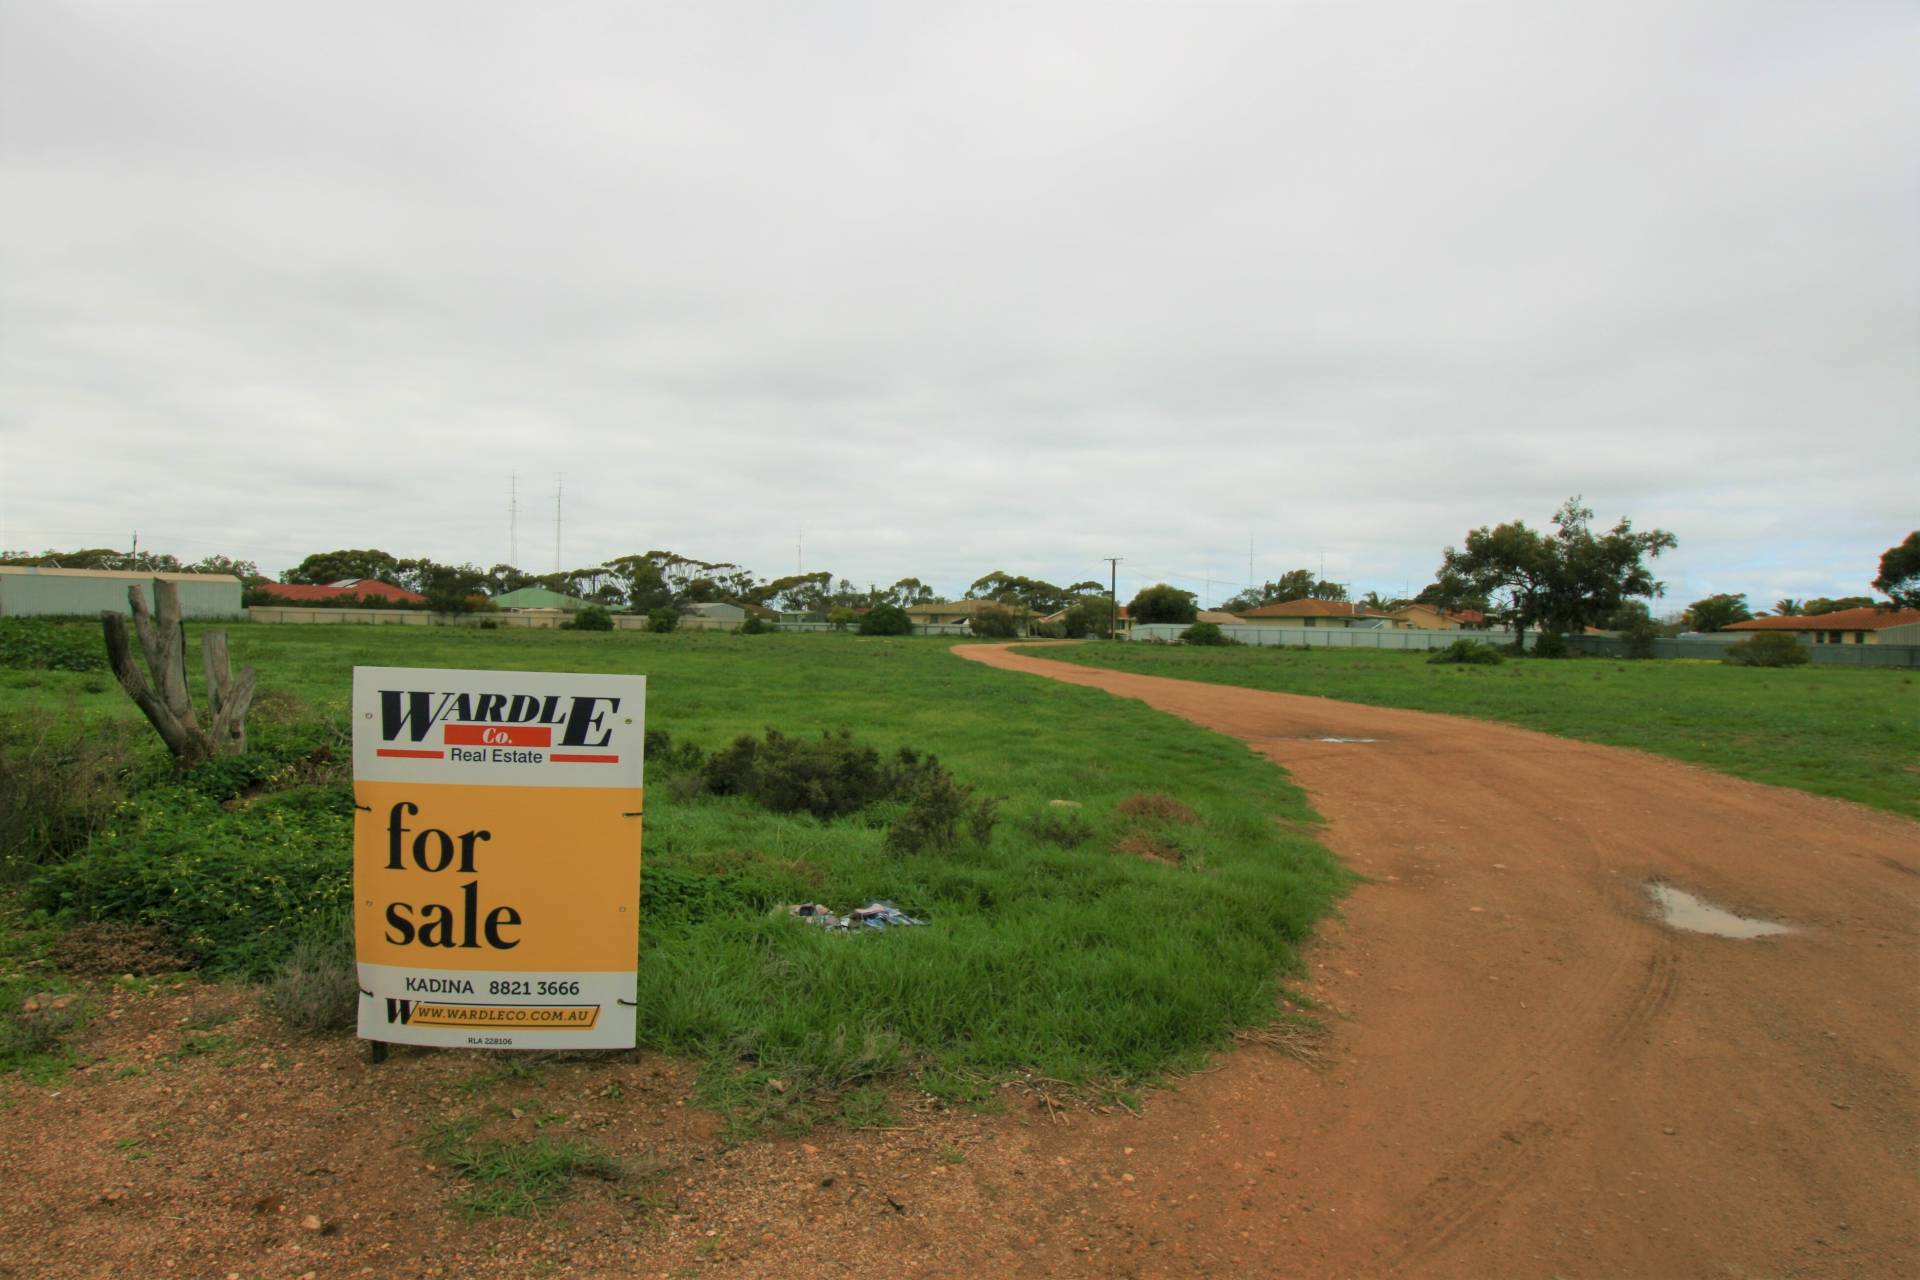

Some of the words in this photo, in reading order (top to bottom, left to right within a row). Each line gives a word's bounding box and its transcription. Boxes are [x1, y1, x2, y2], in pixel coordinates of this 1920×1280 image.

[377, 690, 621, 747] WARDLE
[482, 727, 513, 744] Co.
[450, 747, 487, 763] Real
[492, 749, 543, 764] Estate
[384, 801, 492, 873] for
[385, 880, 522, 950] sale
[405, 977, 475, 995] KADINA
[489, 980, 532, 996] 8821
[537, 981, 580, 996] 3666
[385, 997, 589, 1026] WWW.WARDLECO.COM.AU
[468, 1037, 483, 1045] RLA
[484, 1037, 513, 1046] 228106
